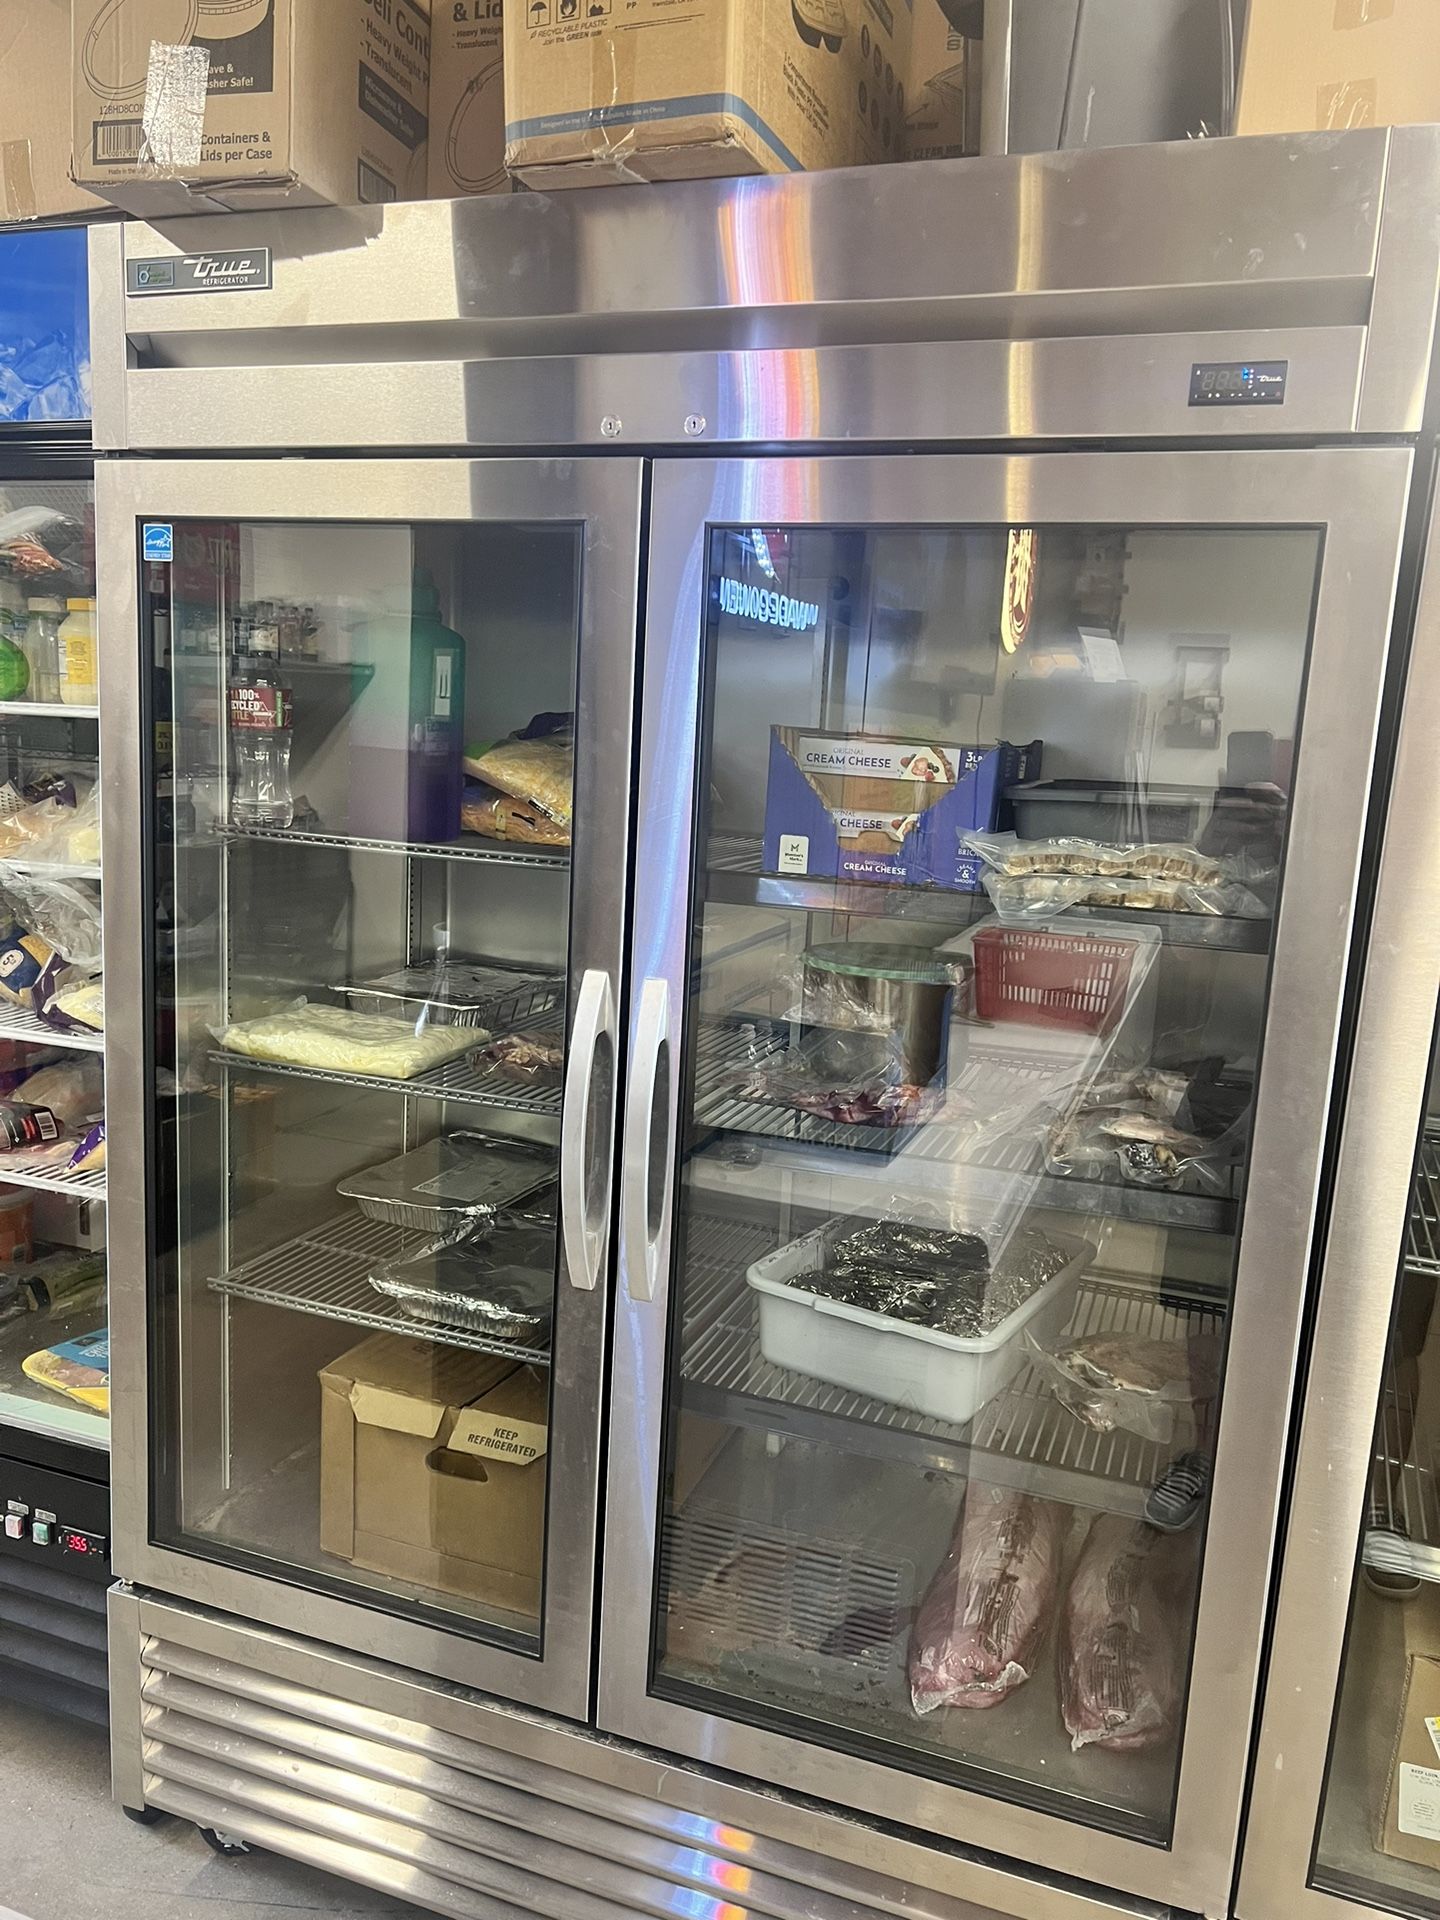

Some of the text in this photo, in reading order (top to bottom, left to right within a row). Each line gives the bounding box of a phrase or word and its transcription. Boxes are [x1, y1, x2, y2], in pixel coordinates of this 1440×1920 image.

[453, 0, 503, 22] & Lid
[538, 18, 608, 38] RECYCLABLE PLASTIC
[566, 31, 589, 41] GREEN
[227, 63, 233, 73] &
[230, 77, 254, 87] Safe!
[201, 131, 271, 145] Containers &
[200, 149, 272, 163] Lids per Case
[202, 276, 249, 286] REFRIGERATOR
[833, 747, 864, 755] ORIGINAL
[806, 752, 846, 765] CREAM
[848, 756, 891, 768] CHEESE
[840, 818, 883, 830] CHEESE
[843, 862, 907, 876] CREAM CHEESE
[962, 870, 969, 879] &
[493, 1428, 518, 1441] KEEP
[468, 1433, 537, 1458] REFRIGERATED
